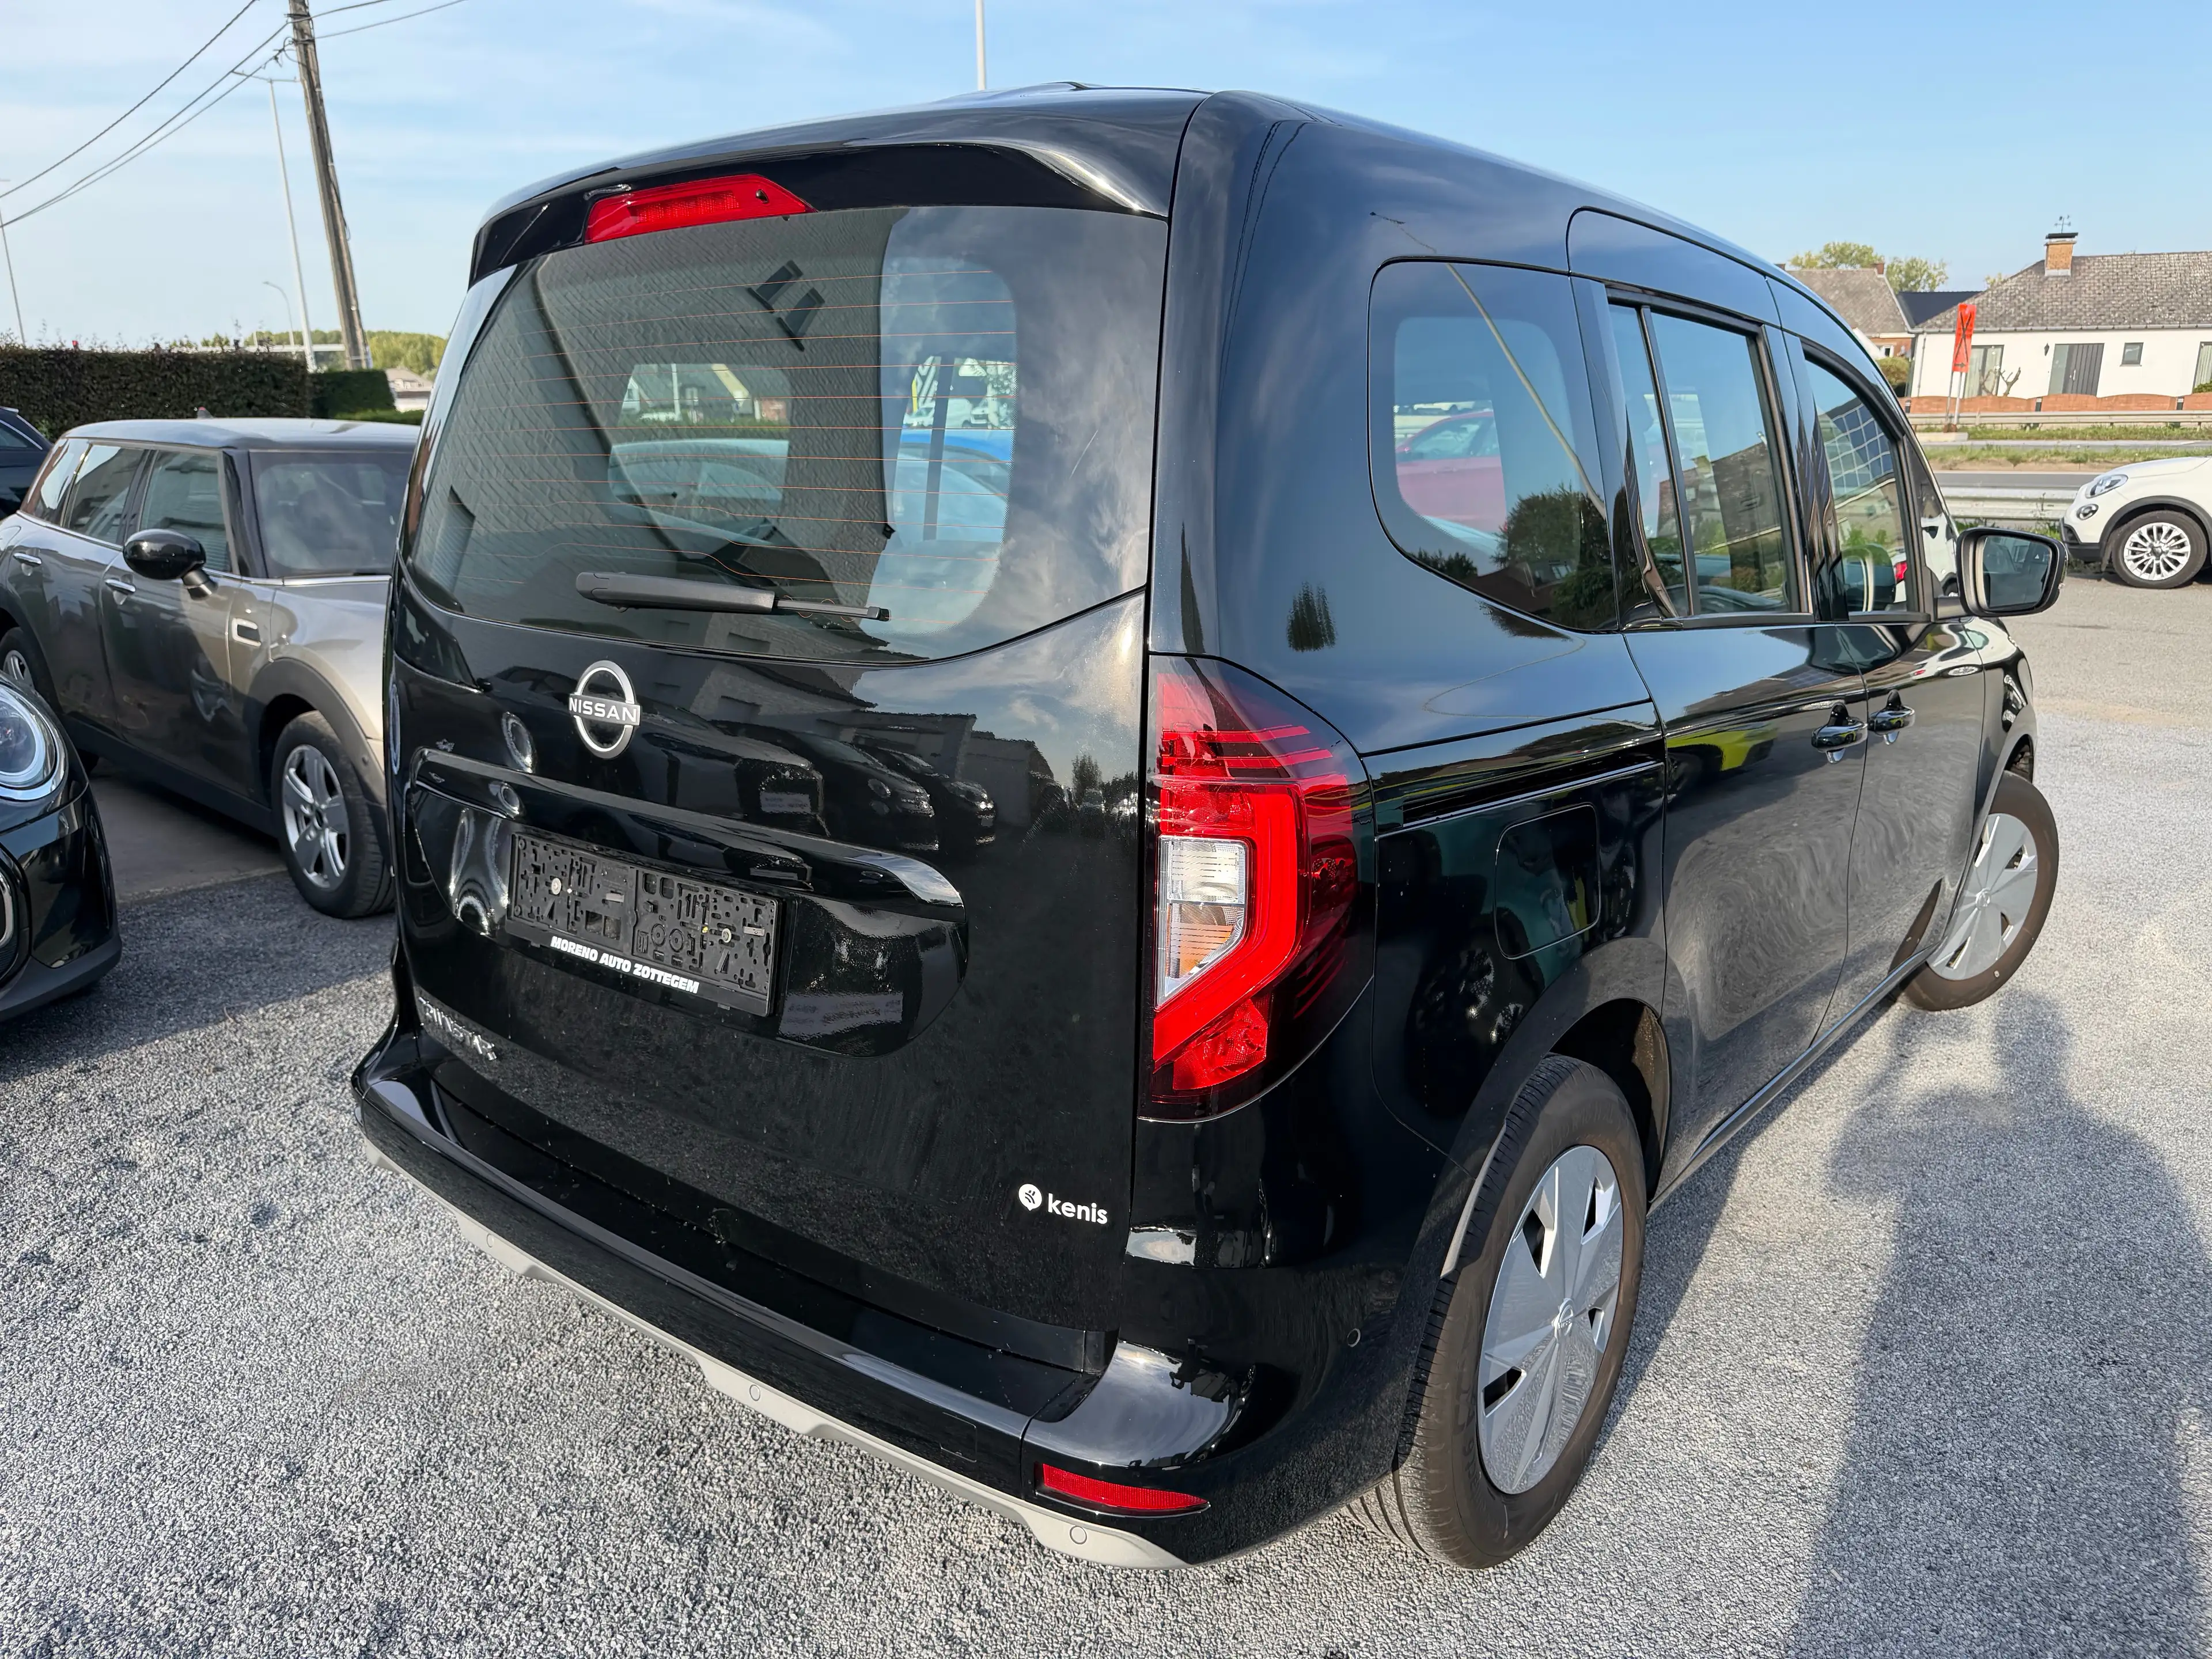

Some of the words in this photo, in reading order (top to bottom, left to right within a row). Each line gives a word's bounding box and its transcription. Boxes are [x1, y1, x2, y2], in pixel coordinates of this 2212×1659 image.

[569, 697, 637, 722] NISSAN
[550, 935, 598, 961] MORENO
[599, 953, 631, 972] AUTO
[633, 963, 700, 994] ZOTTEGEM
[1047, 1192, 1108, 1225] kenis
